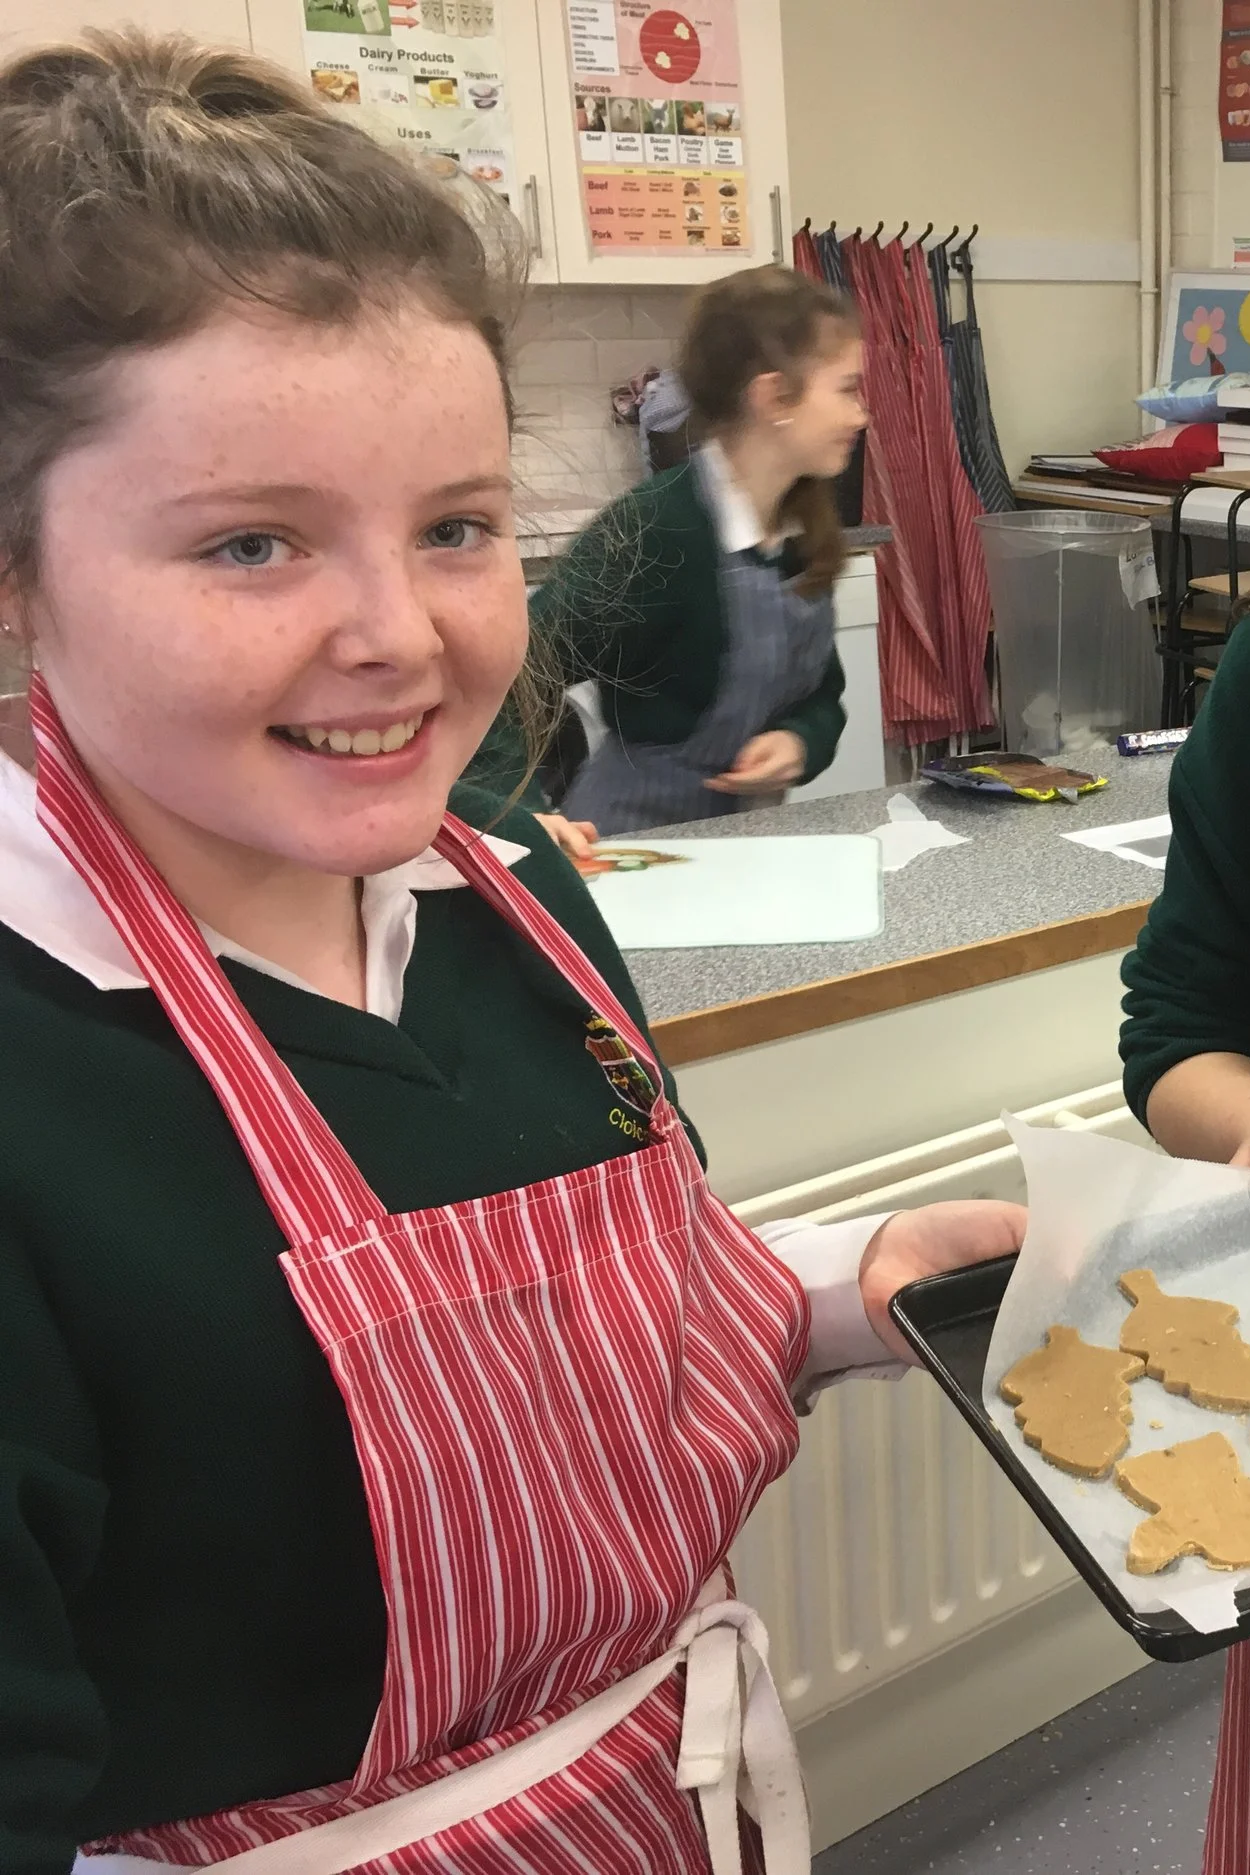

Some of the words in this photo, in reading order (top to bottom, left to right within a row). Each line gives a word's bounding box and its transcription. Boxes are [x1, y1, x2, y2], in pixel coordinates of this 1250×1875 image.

[359, 46, 393, 62] Dairy
[397, 49, 454, 64] Products
[316, 61, 350, 70] Cheese
[368, 64, 398, 73] Cream
[420, 67, 449, 76] Butter
[464, 70, 498, 80] Yoghurt
[574, 82, 611, 94] Sources
[397, 127, 432, 139] Uses
[650, 136, 671, 144] Bacon
[681, 138, 703, 147] Poultry
[714, 139, 733, 147] Game
[616, 144, 639, 152] Mutton
[588, 181, 608, 190] Beef
[589, 206, 614, 215] Lamb
[592, 229, 612, 239] Pork
